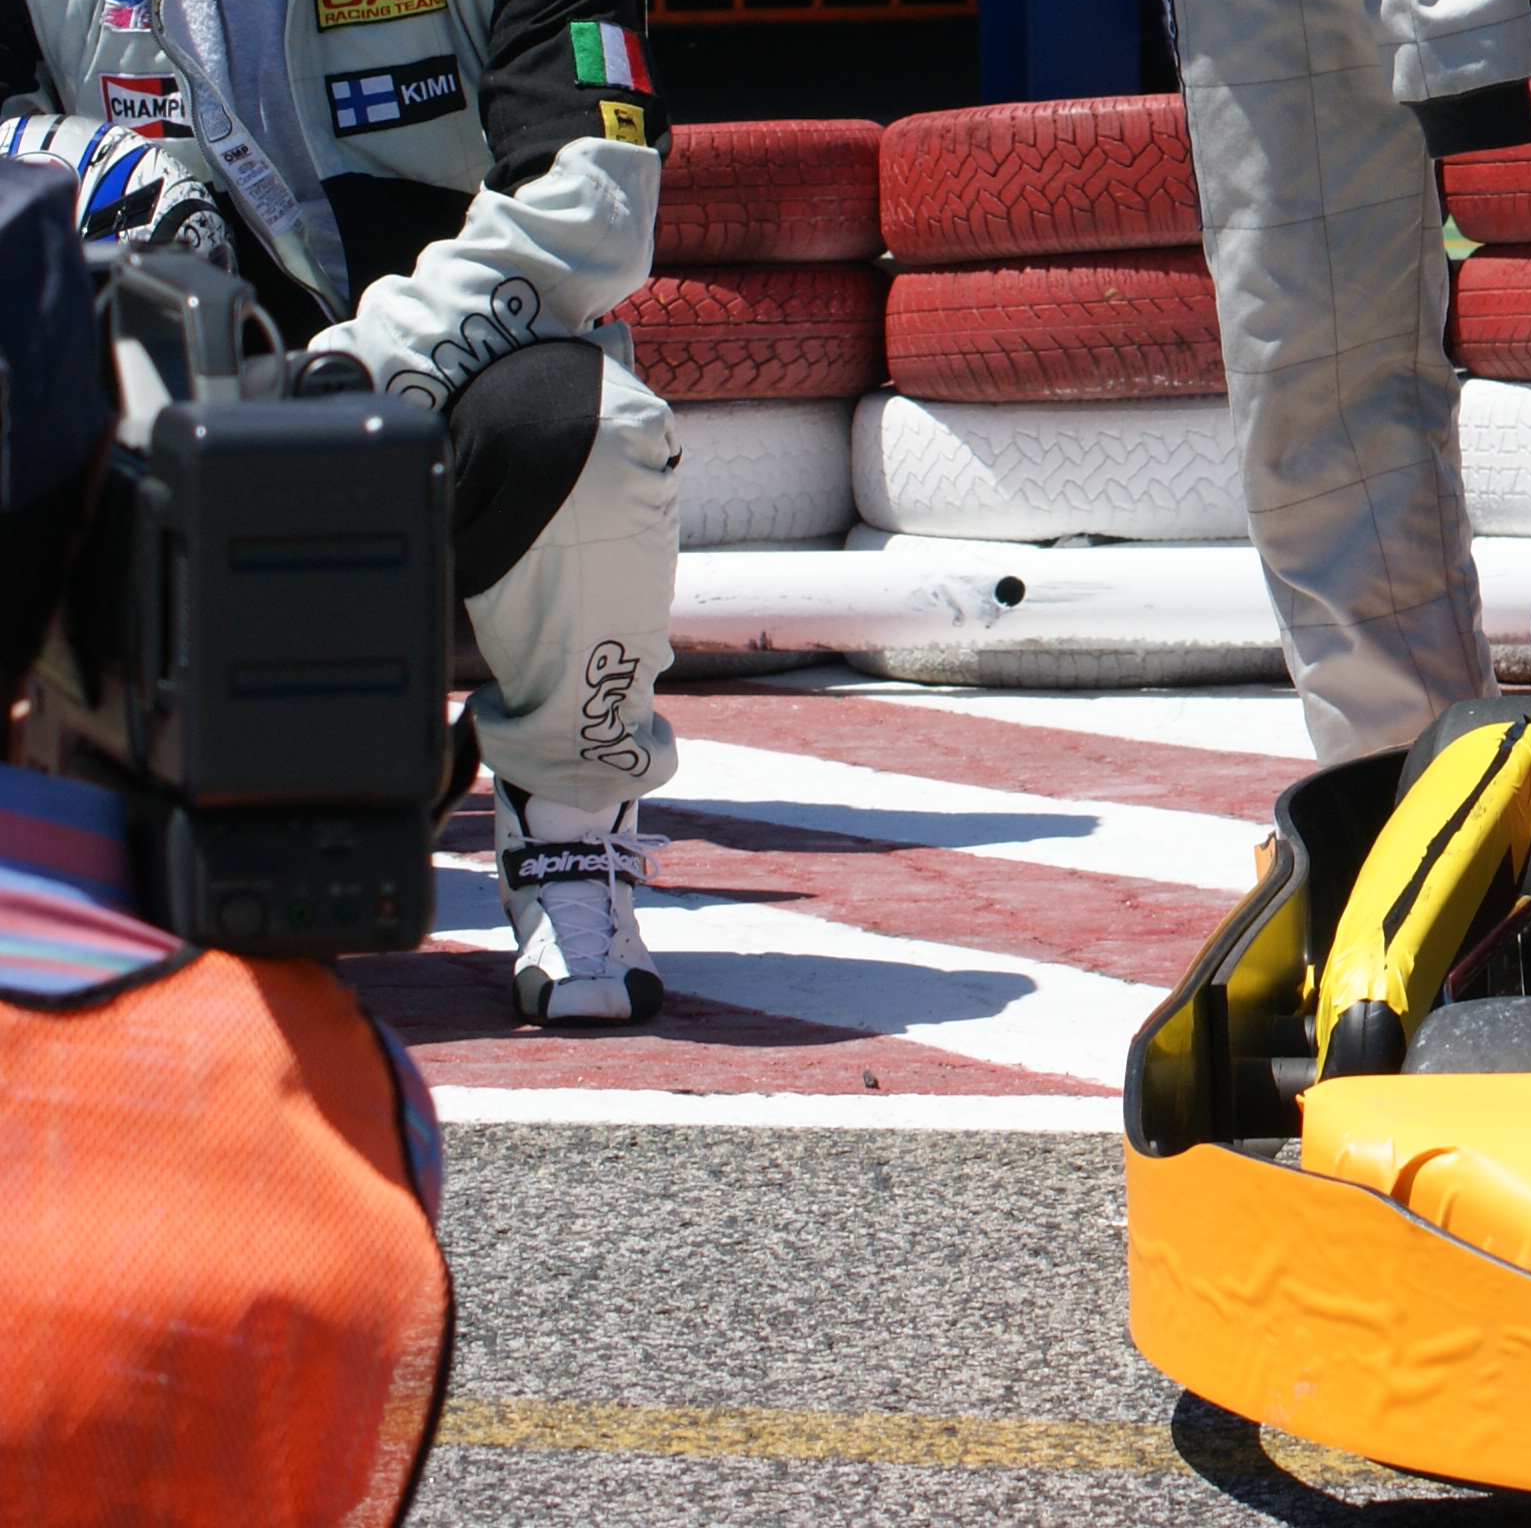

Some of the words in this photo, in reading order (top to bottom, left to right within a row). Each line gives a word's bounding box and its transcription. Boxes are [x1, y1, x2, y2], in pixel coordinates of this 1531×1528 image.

[325, 3, 392, 24] RACING
[401, 74, 456, 105] KIMI
[224, 145, 249, 162] OMP
